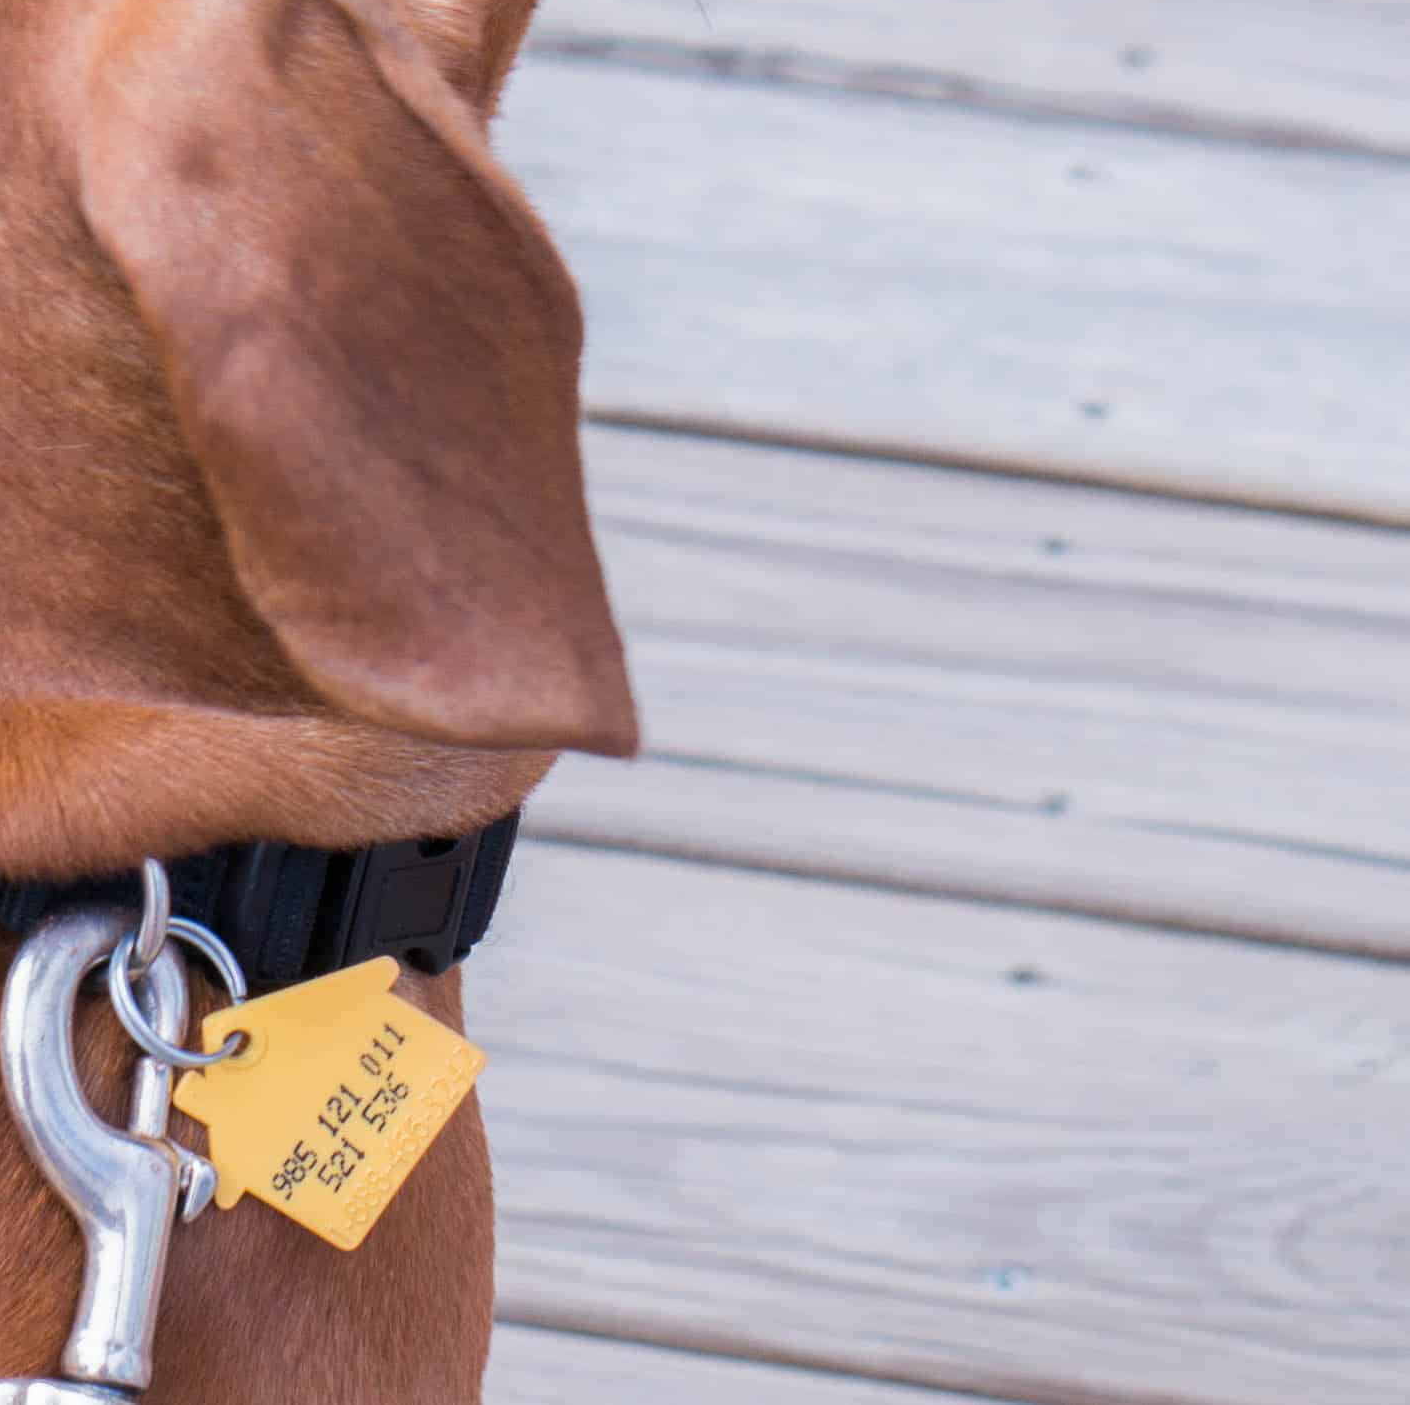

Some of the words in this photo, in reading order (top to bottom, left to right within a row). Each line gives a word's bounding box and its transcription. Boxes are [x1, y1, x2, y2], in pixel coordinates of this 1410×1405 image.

[272, 1140, 318, 1201] 985
[317, 1084, 363, 1137] 121
[359, 1023, 406, 1076] 011
[317, 1138, 365, 1193] 521
[361, 1071, 410, 1132] 536
